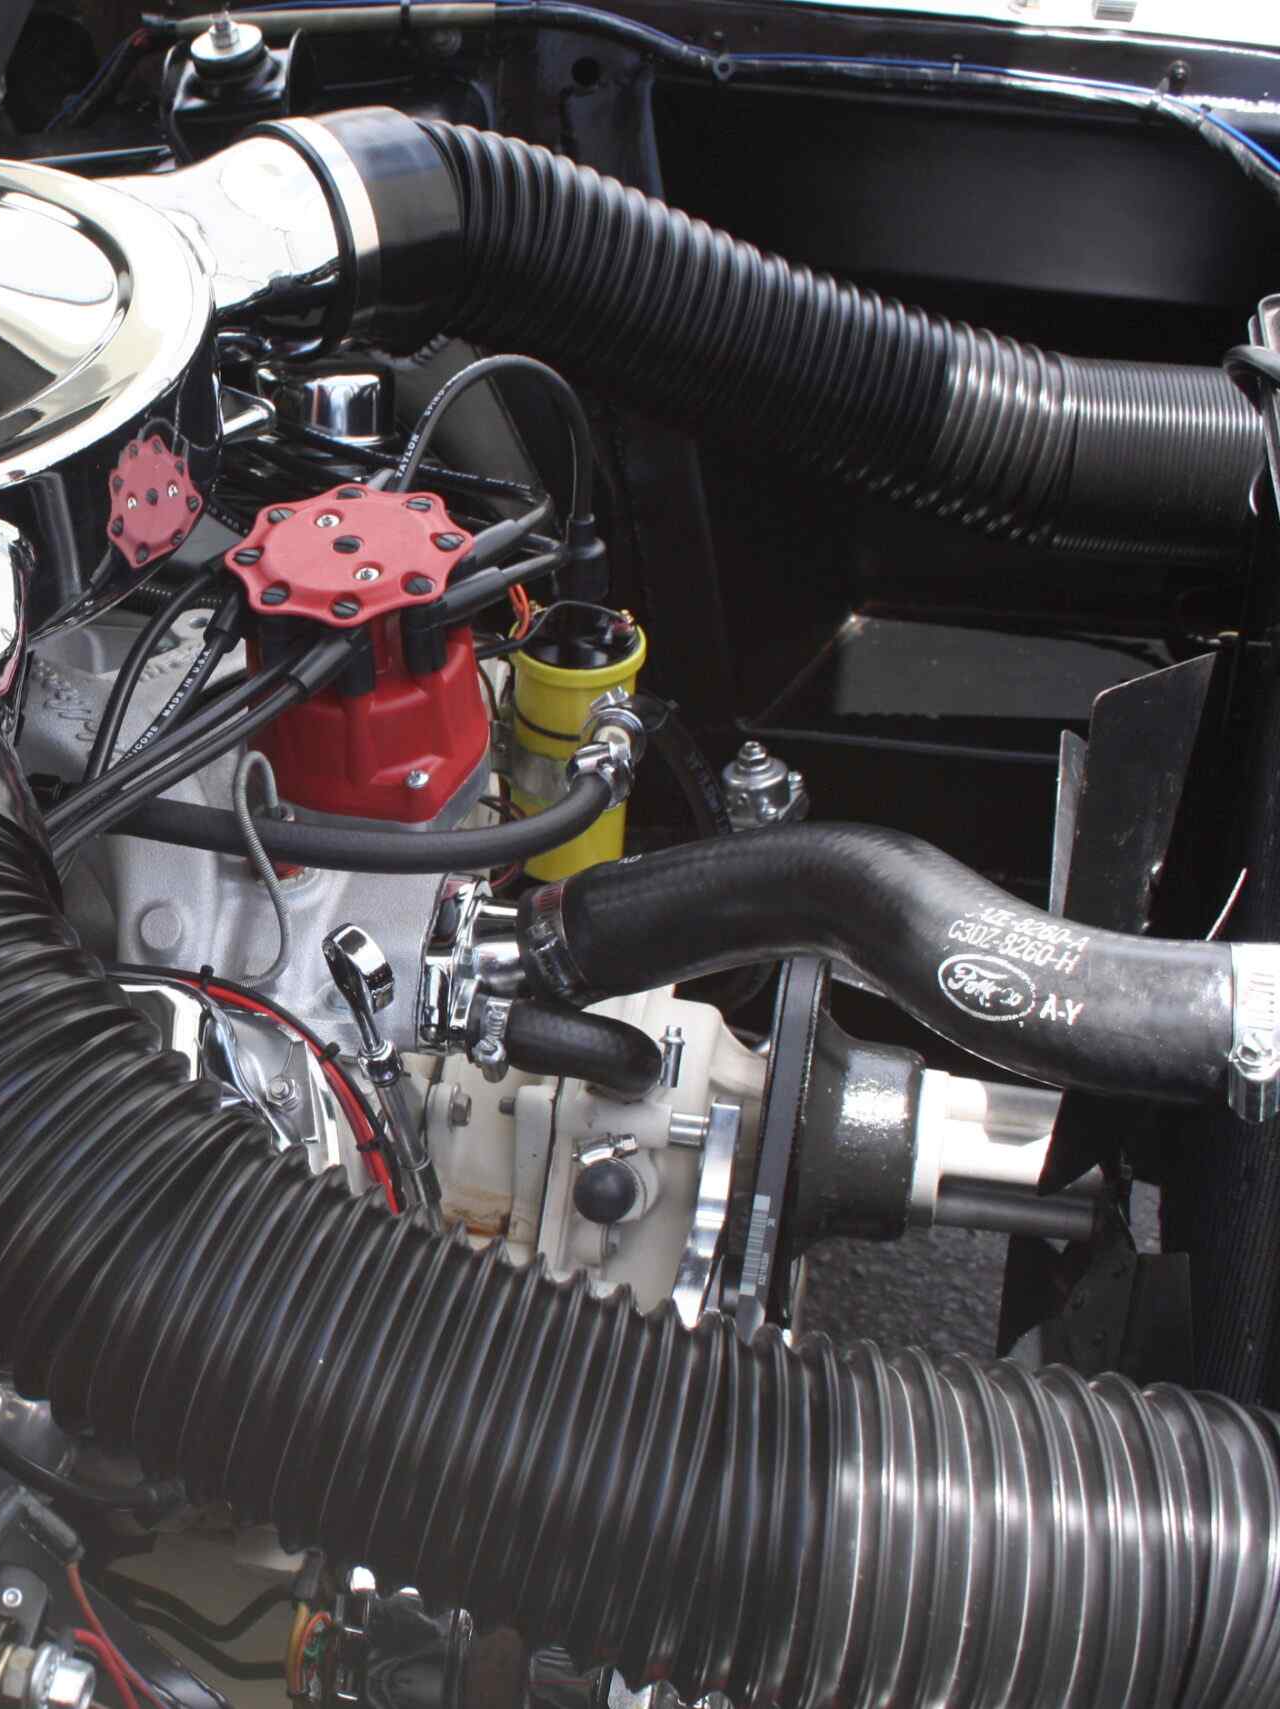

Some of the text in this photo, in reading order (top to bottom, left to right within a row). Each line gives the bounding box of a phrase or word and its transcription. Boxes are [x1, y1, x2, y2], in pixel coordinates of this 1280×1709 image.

[394, 433, 420, 479] TAYLOR
[162, 692, 185, 717] MADE
[183, 678, 193, 688] IN
[192, 649, 212, 673] U.S.A.
[964, 903, 1091, 953] ZE-8260-A
